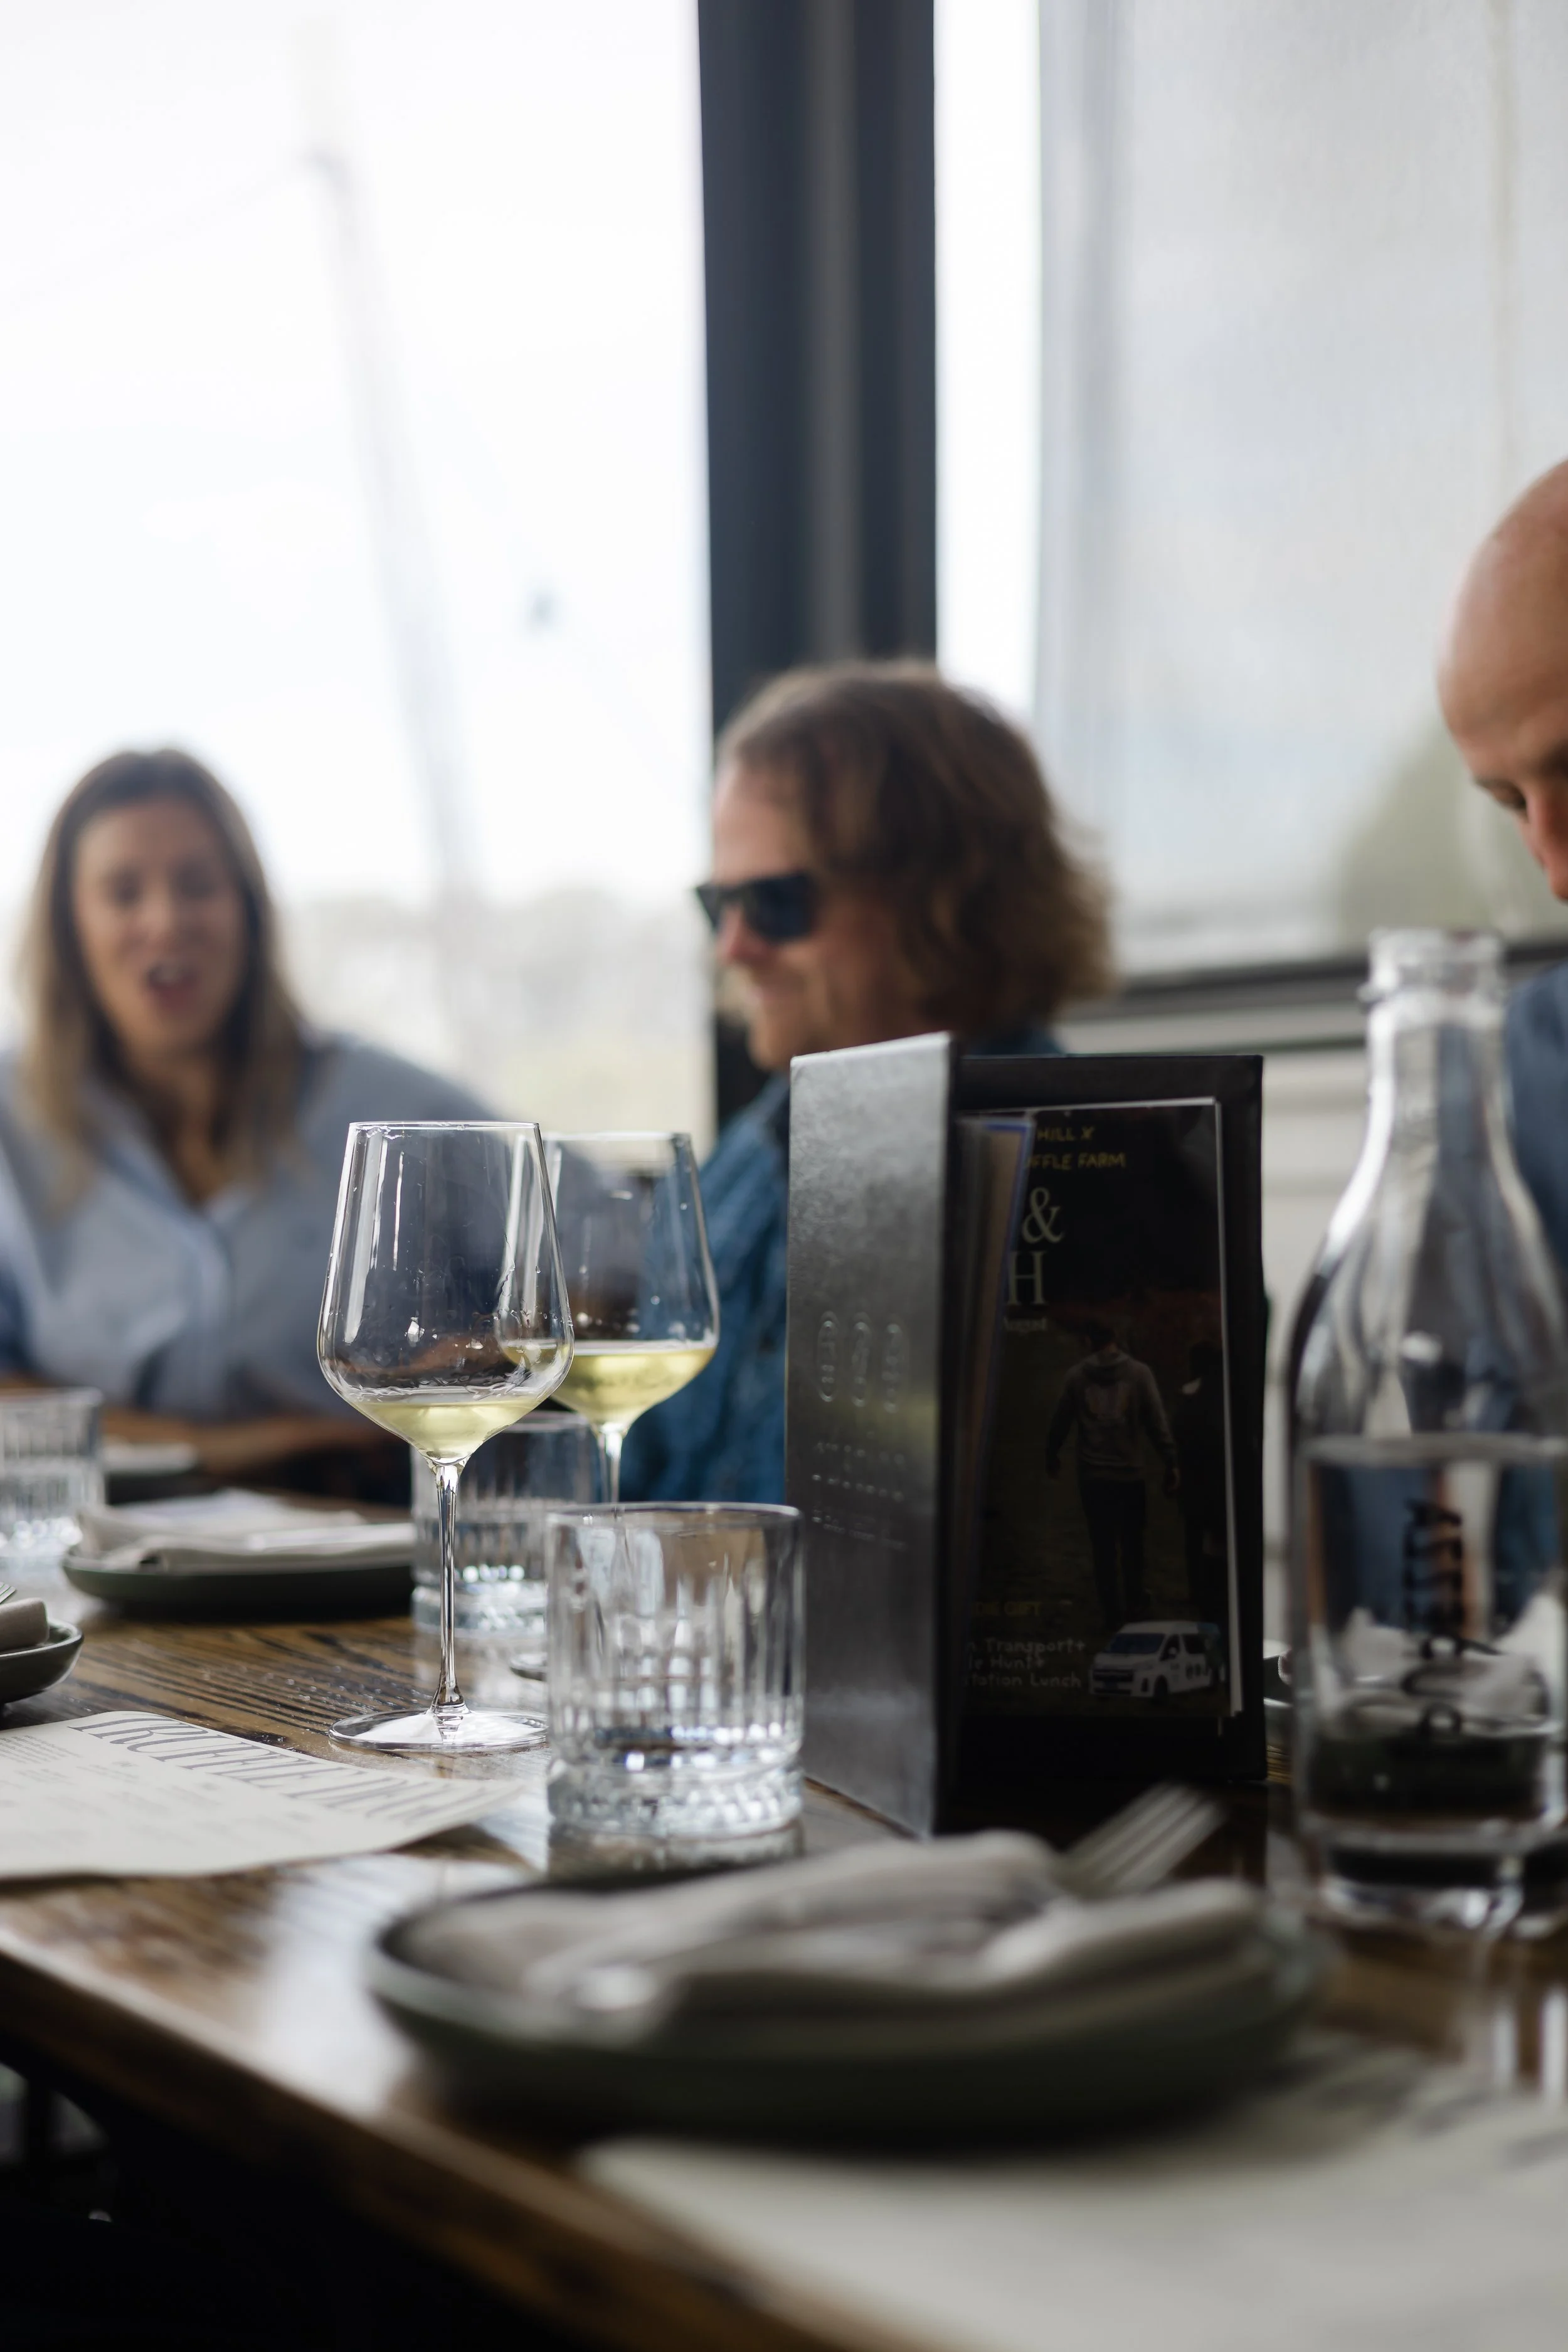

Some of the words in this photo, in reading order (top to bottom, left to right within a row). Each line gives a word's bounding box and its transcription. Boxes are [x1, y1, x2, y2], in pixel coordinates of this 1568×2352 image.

[1037, 1126, 1076, 1142] HILL
[1078, 1152, 1125, 1168] FARM
[1022, 1186, 1064, 1243] &
[1030, 1671, 1082, 1687] Lunch
[68, 1716, 366, 1789] TRUFFLE
